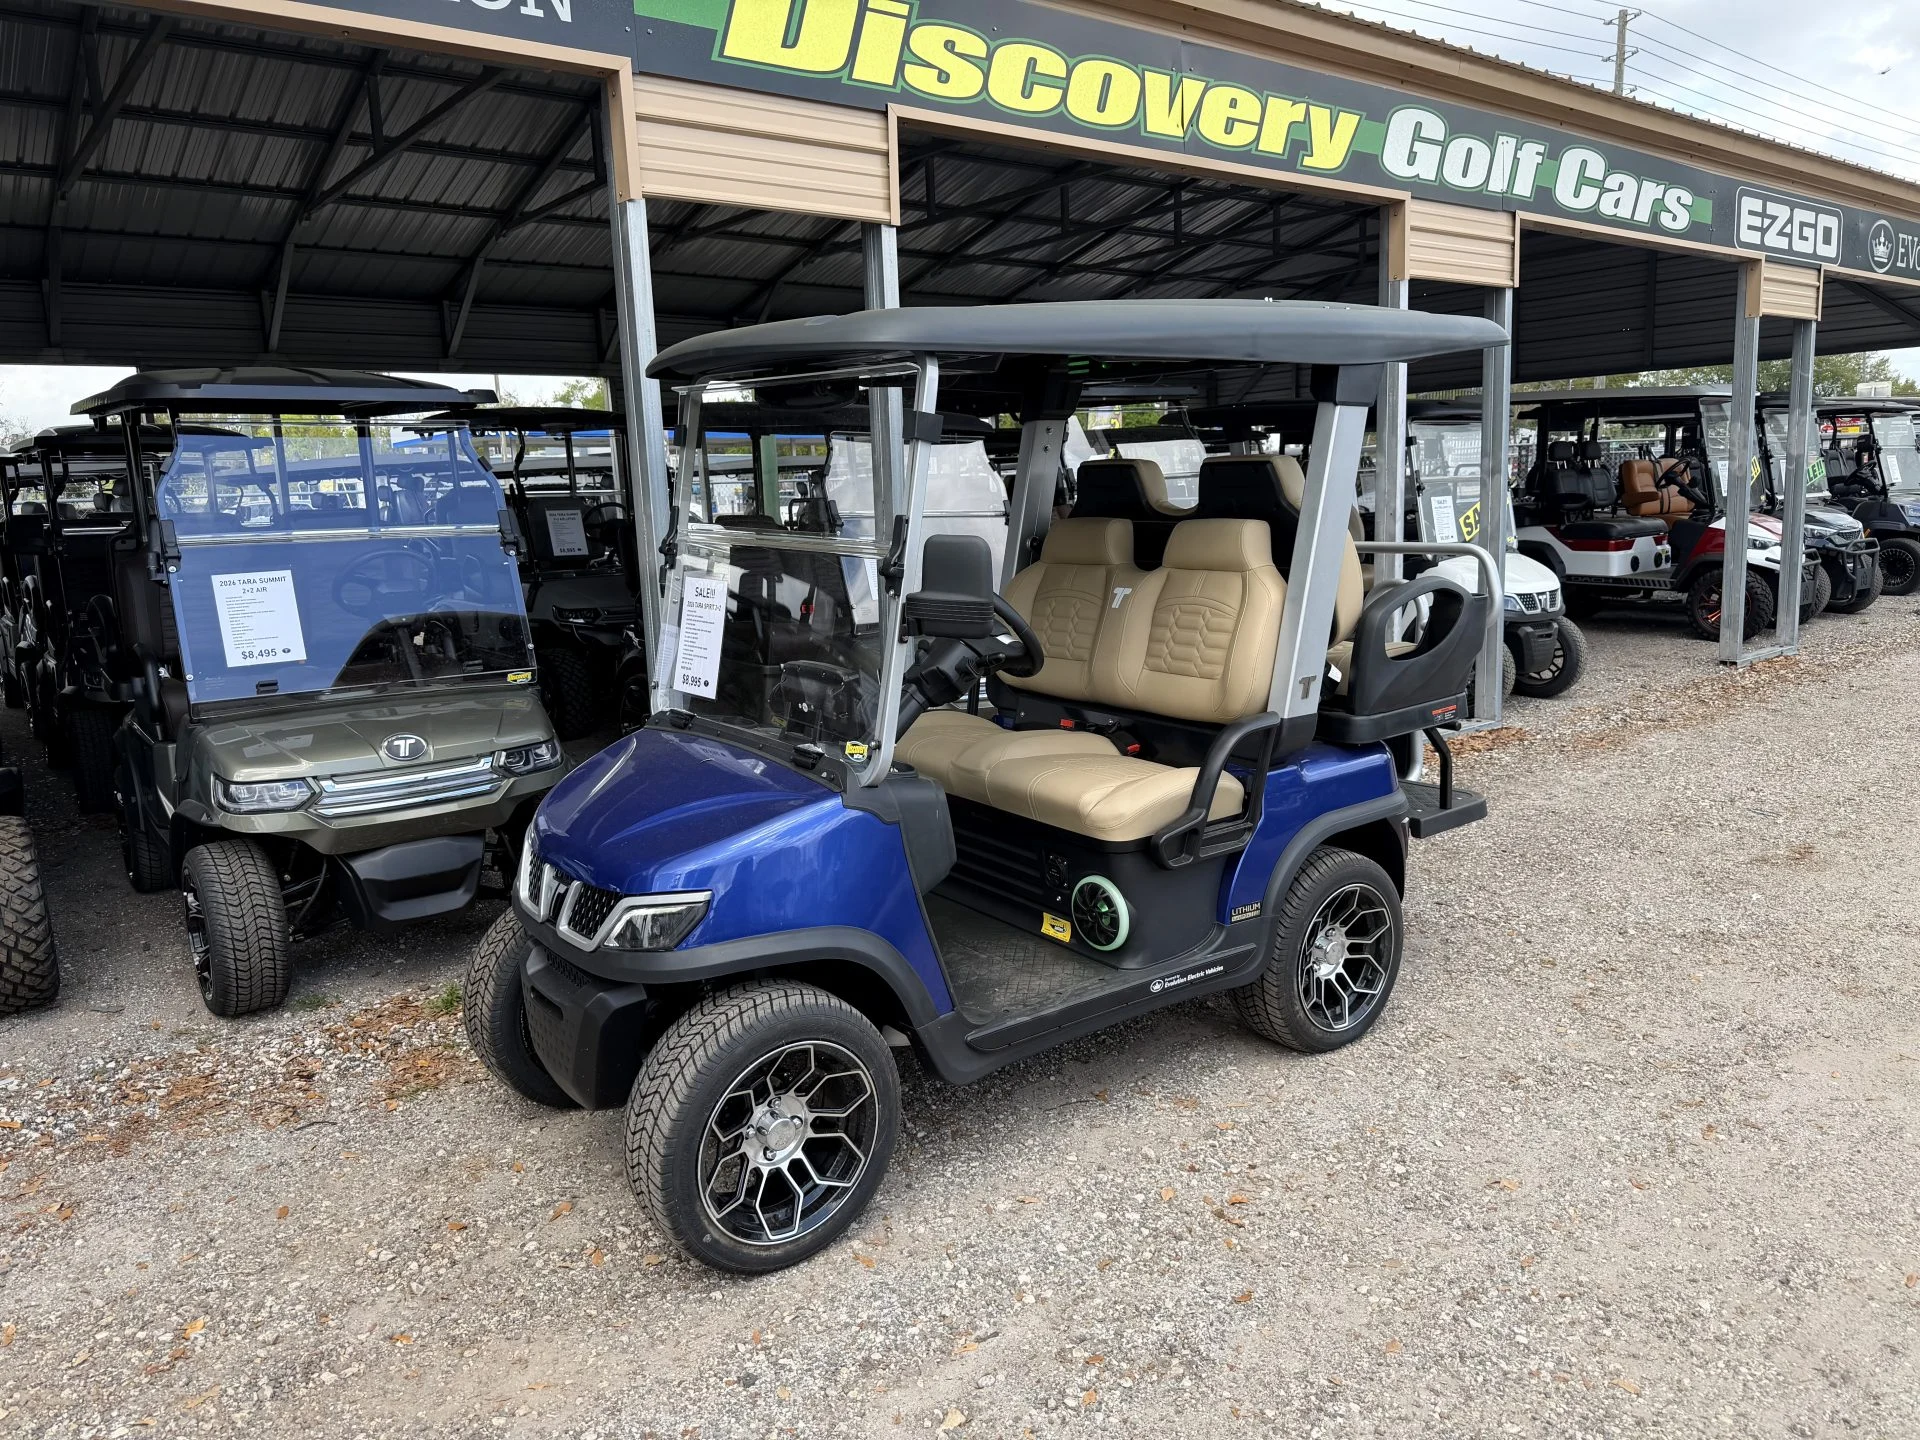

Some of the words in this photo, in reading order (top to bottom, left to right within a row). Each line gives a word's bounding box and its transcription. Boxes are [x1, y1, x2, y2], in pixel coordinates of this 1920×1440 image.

[722, 0, 1362, 170] Discovery
[1382, 107, 1546, 198] Golf
[1554, 147, 1693, 232] Cars
[1896, 232, 1920, 272] EV
[237, 578, 258, 586] TARA
[259, 576, 287, 584] SUMMIT
[241, 648, 277, 660] $8,495
[682, 673, 702, 688] $8,995
[1231, 902, 1261, 915] LITHIUM
[1165, 977, 1187, 988] Evolution
[1187, 970, 1205, 981] Electric
[1206, 965, 1224, 975] Vehicles
